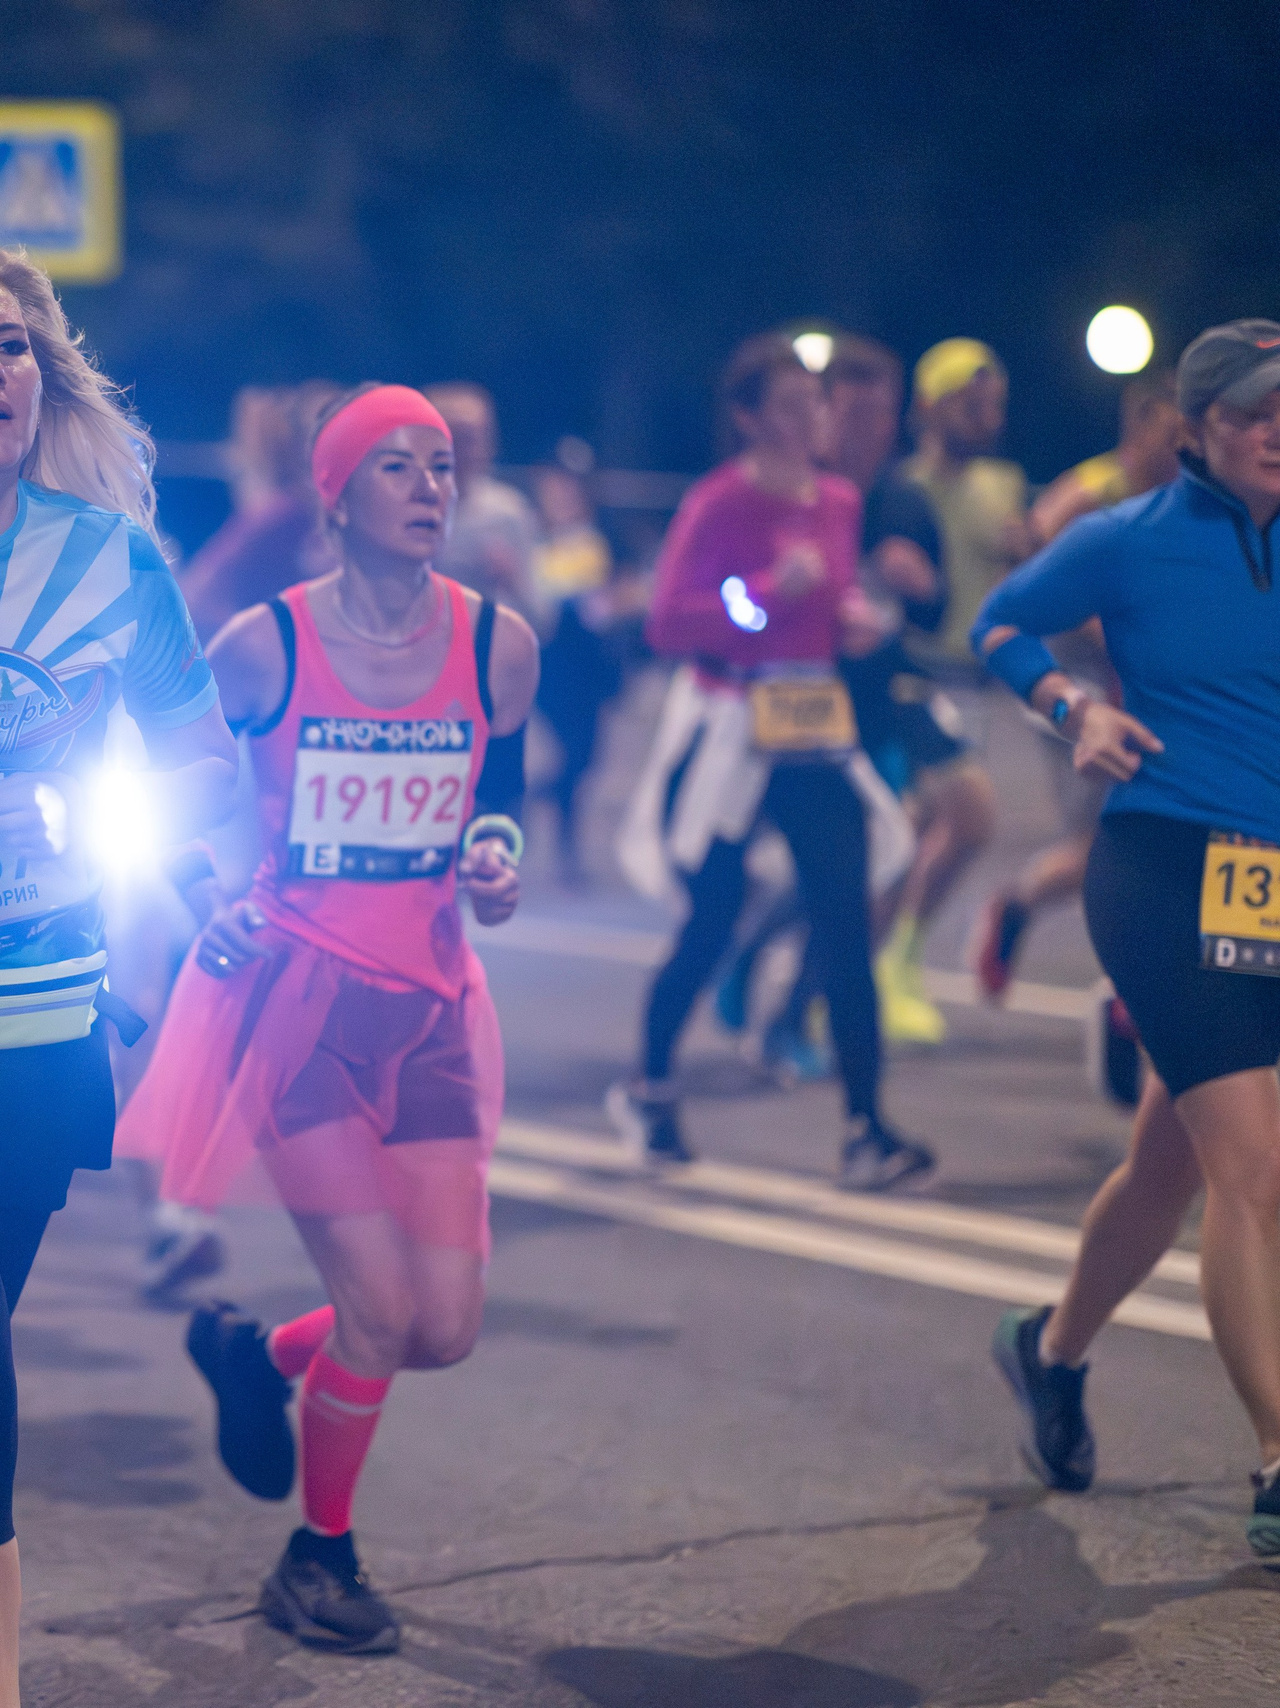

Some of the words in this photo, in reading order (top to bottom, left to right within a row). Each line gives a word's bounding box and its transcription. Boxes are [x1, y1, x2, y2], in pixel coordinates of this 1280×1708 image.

[307, 774, 461, 825] 19192
[1216, 859, 1280, 911] 13
[1215, 937, 1237, 968] D
